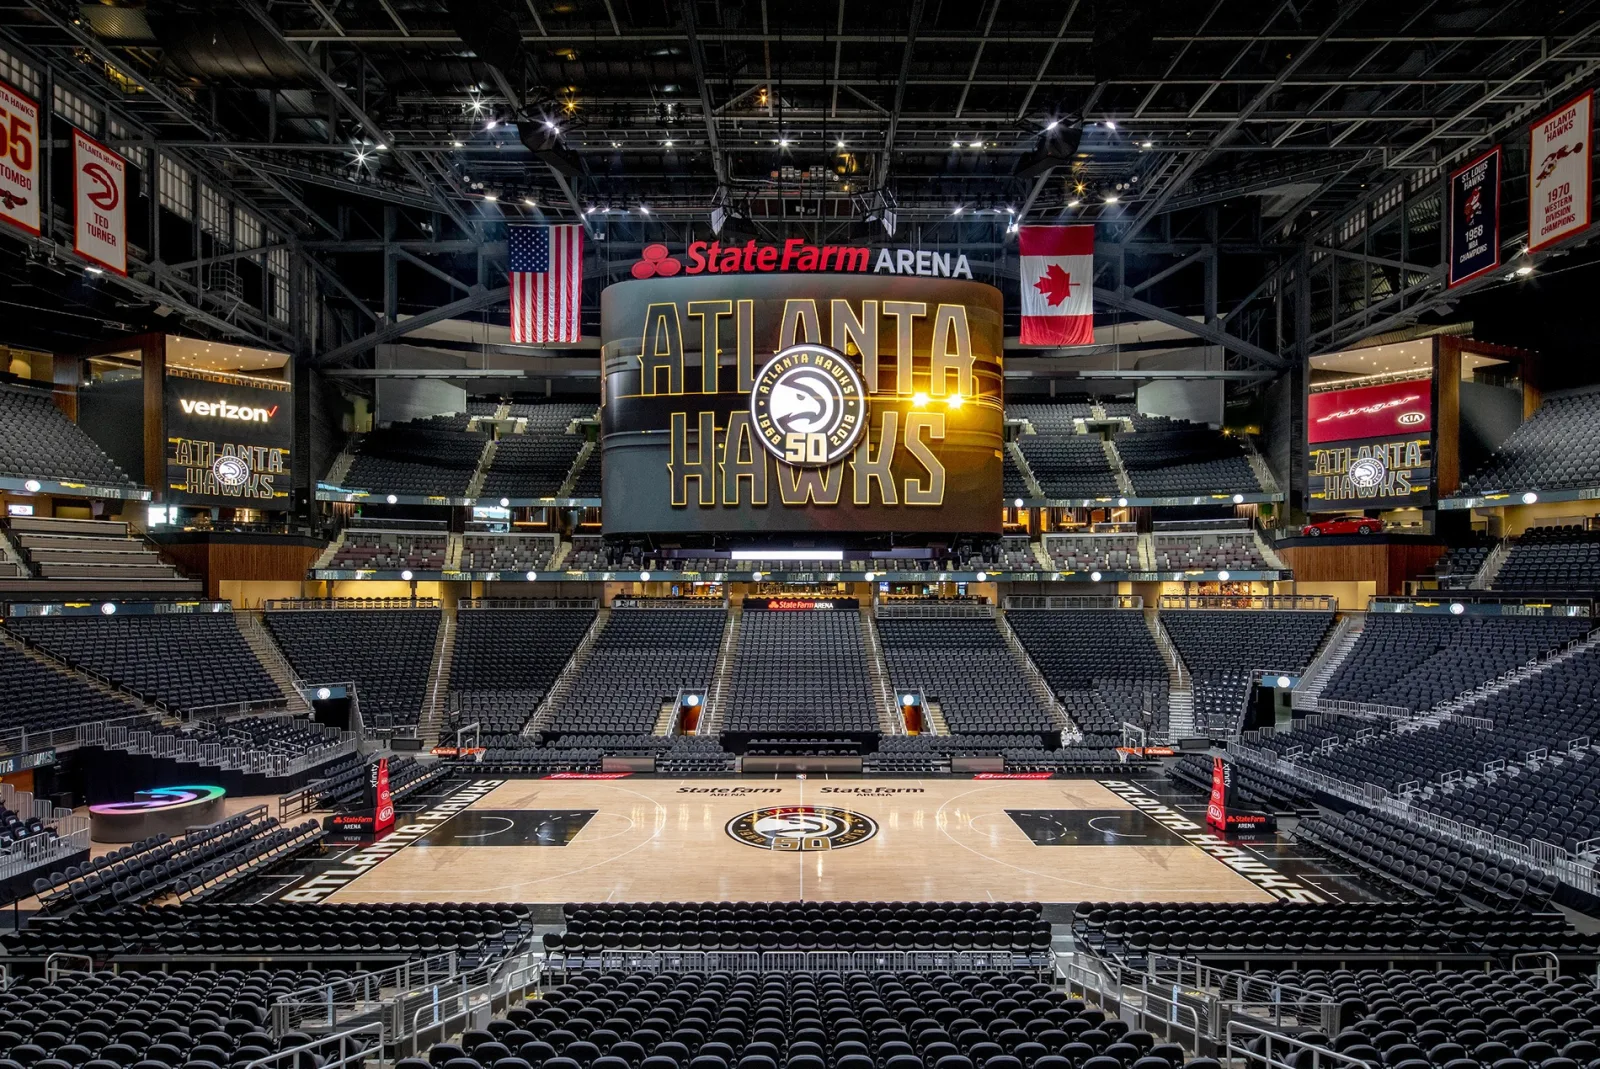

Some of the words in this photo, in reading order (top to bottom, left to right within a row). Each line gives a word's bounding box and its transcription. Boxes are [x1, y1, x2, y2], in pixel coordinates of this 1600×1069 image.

[10, 97, 35, 118] HAWKS
[1544, 108, 1577, 135] ATLANTA
[1547, 119, 1573, 143] HAWKS
[78, 140, 103, 160] ATLANTA
[103, 155, 122, 172] HAWKS
[0, 164, 31, 191] TOMBO
[1464, 171, 1485, 191] HAWKS
[1471, 160, 1488, 178] LOUIS
[1545, 194, 1572, 214] WESTERN
[1548, 182, 1570, 203] 1970
[94, 212, 109, 230] TED
[1541, 213, 1576, 236] CHAMPIONS
[1546, 205, 1571, 224] DIVISION
[86, 222, 117, 247] TURNER
[1465, 224, 1483, 243] 1958
[874, 248, 973, 280] ARENA
[1460, 243, 1488, 263] CHAMPIONS
[637, 298, 977, 396] ATLANTA
[759, 353, 809, 394] ATLANTA
[815, 355, 855, 394] HAWKS
[180, 399, 268, 422] verizon
[758, 413, 782, 445] 1968
[830, 414, 855, 446] 2018
[175, 439, 283, 473] ATLANTA
[785, 432, 828, 463] 50
[1315, 440, 1422, 475] ATLANTA
[224, 476, 238, 486] 50
[779, 601, 797, 609] State
[797, 601, 814, 609] Farm
[370, 763, 379, 788] xfinity
[1223, 763, 1232, 788] xfinity
[280, 823, 435, 903] ATLANTA
[416, 780, 504, 820] HAWKS
[771, 836, 832, 850] 50
[1099, 780, 1202, 830] ATLANTA
[1184, 834, 1327, 903] HAWKS
